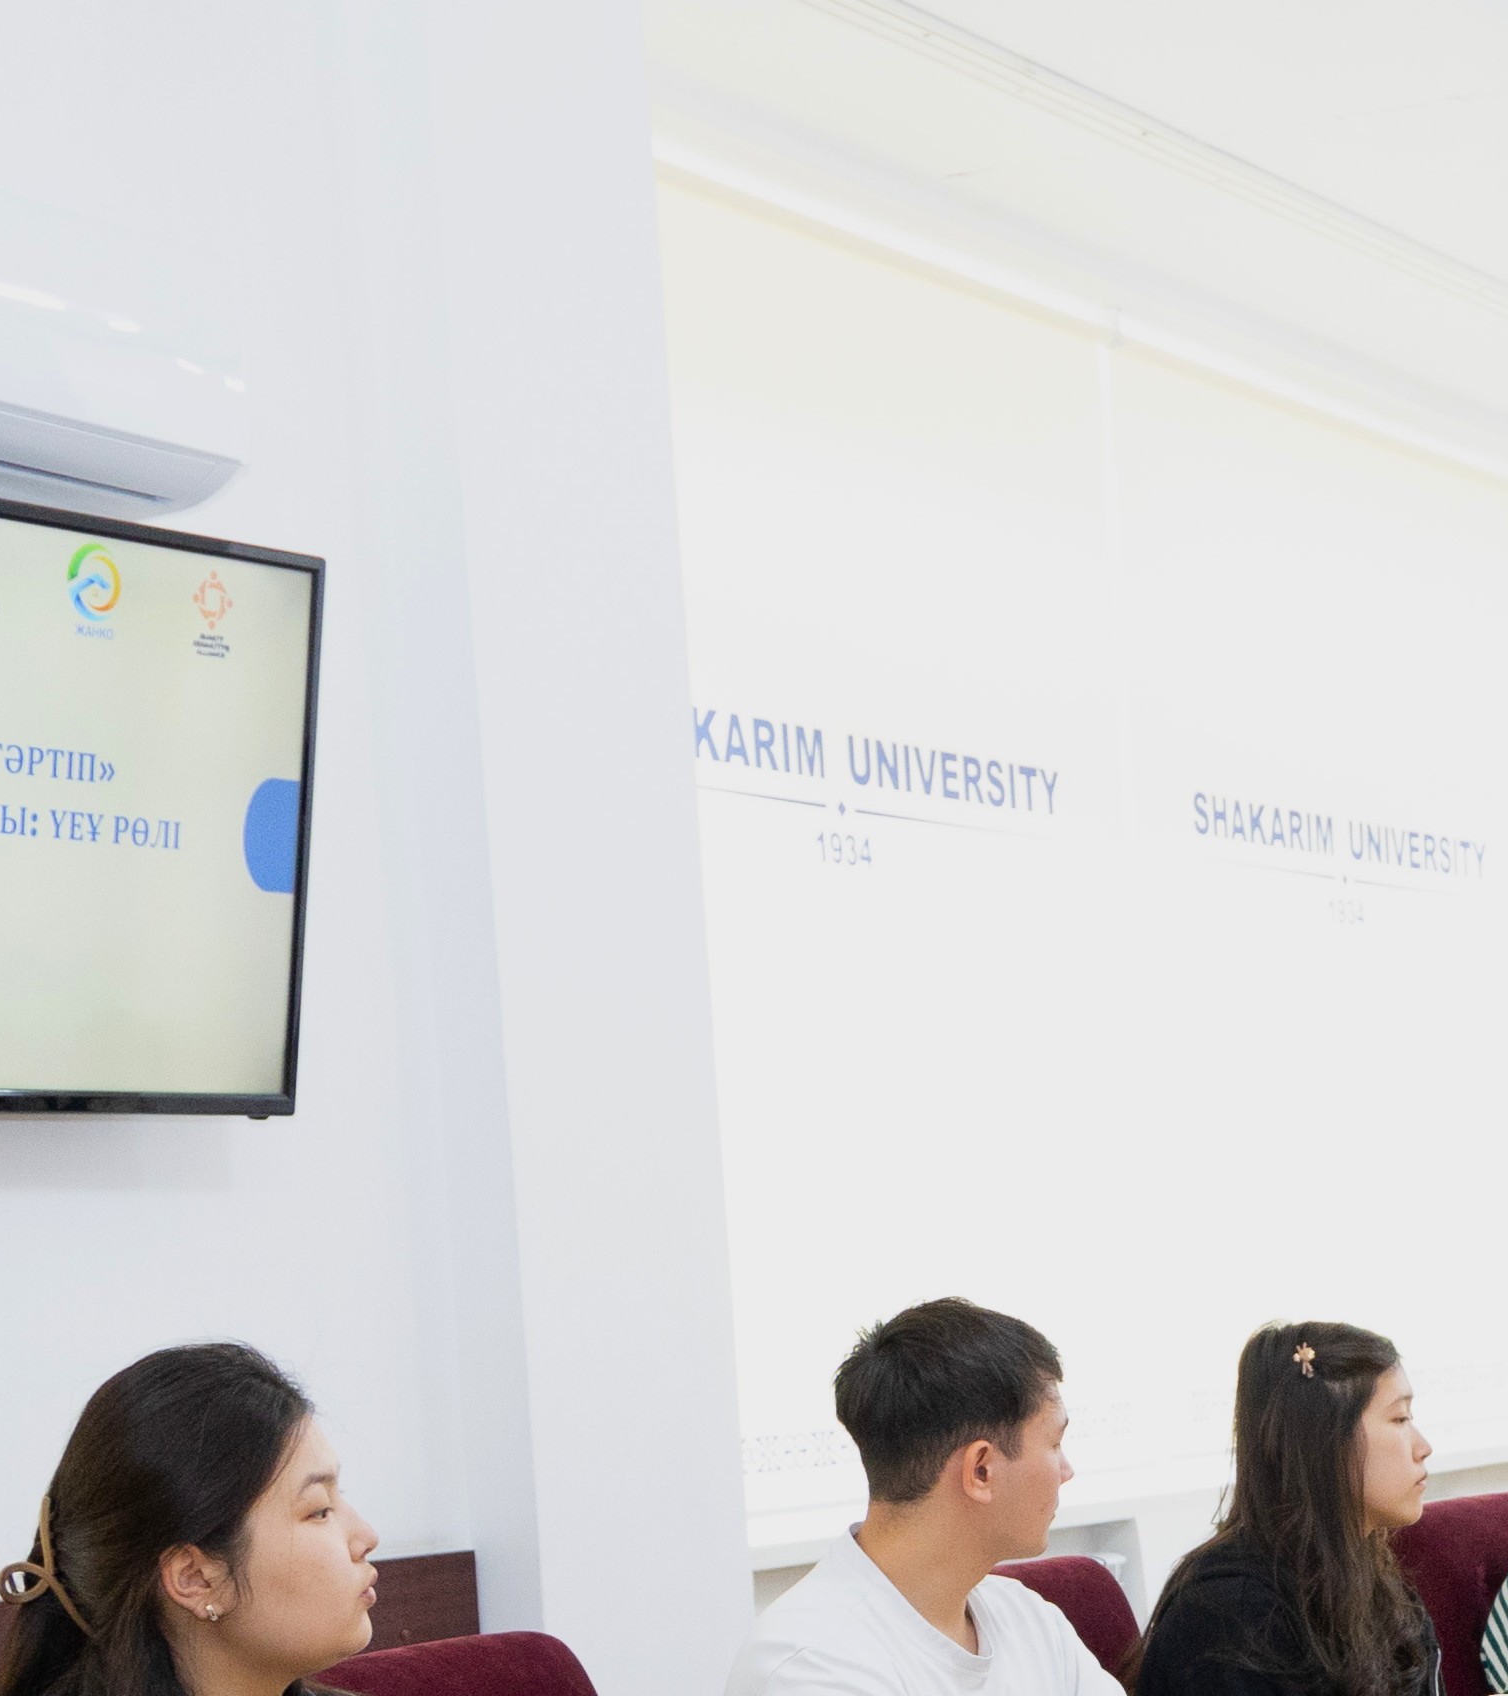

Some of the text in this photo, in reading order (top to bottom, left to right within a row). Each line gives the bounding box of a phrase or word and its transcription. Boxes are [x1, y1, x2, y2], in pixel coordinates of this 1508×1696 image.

[847, 734, 1059, 815] UNIVERSITY
[49, 808, 103, 842] ҮЕҰ
[112, 816, 182, 850] РӨЛІ
[817, 832, 873, 868] 1934
[1193, 791, 1487, 878] SHAKARIM UNIVERSITY
[1329, 898, 1365, 926] 1934
